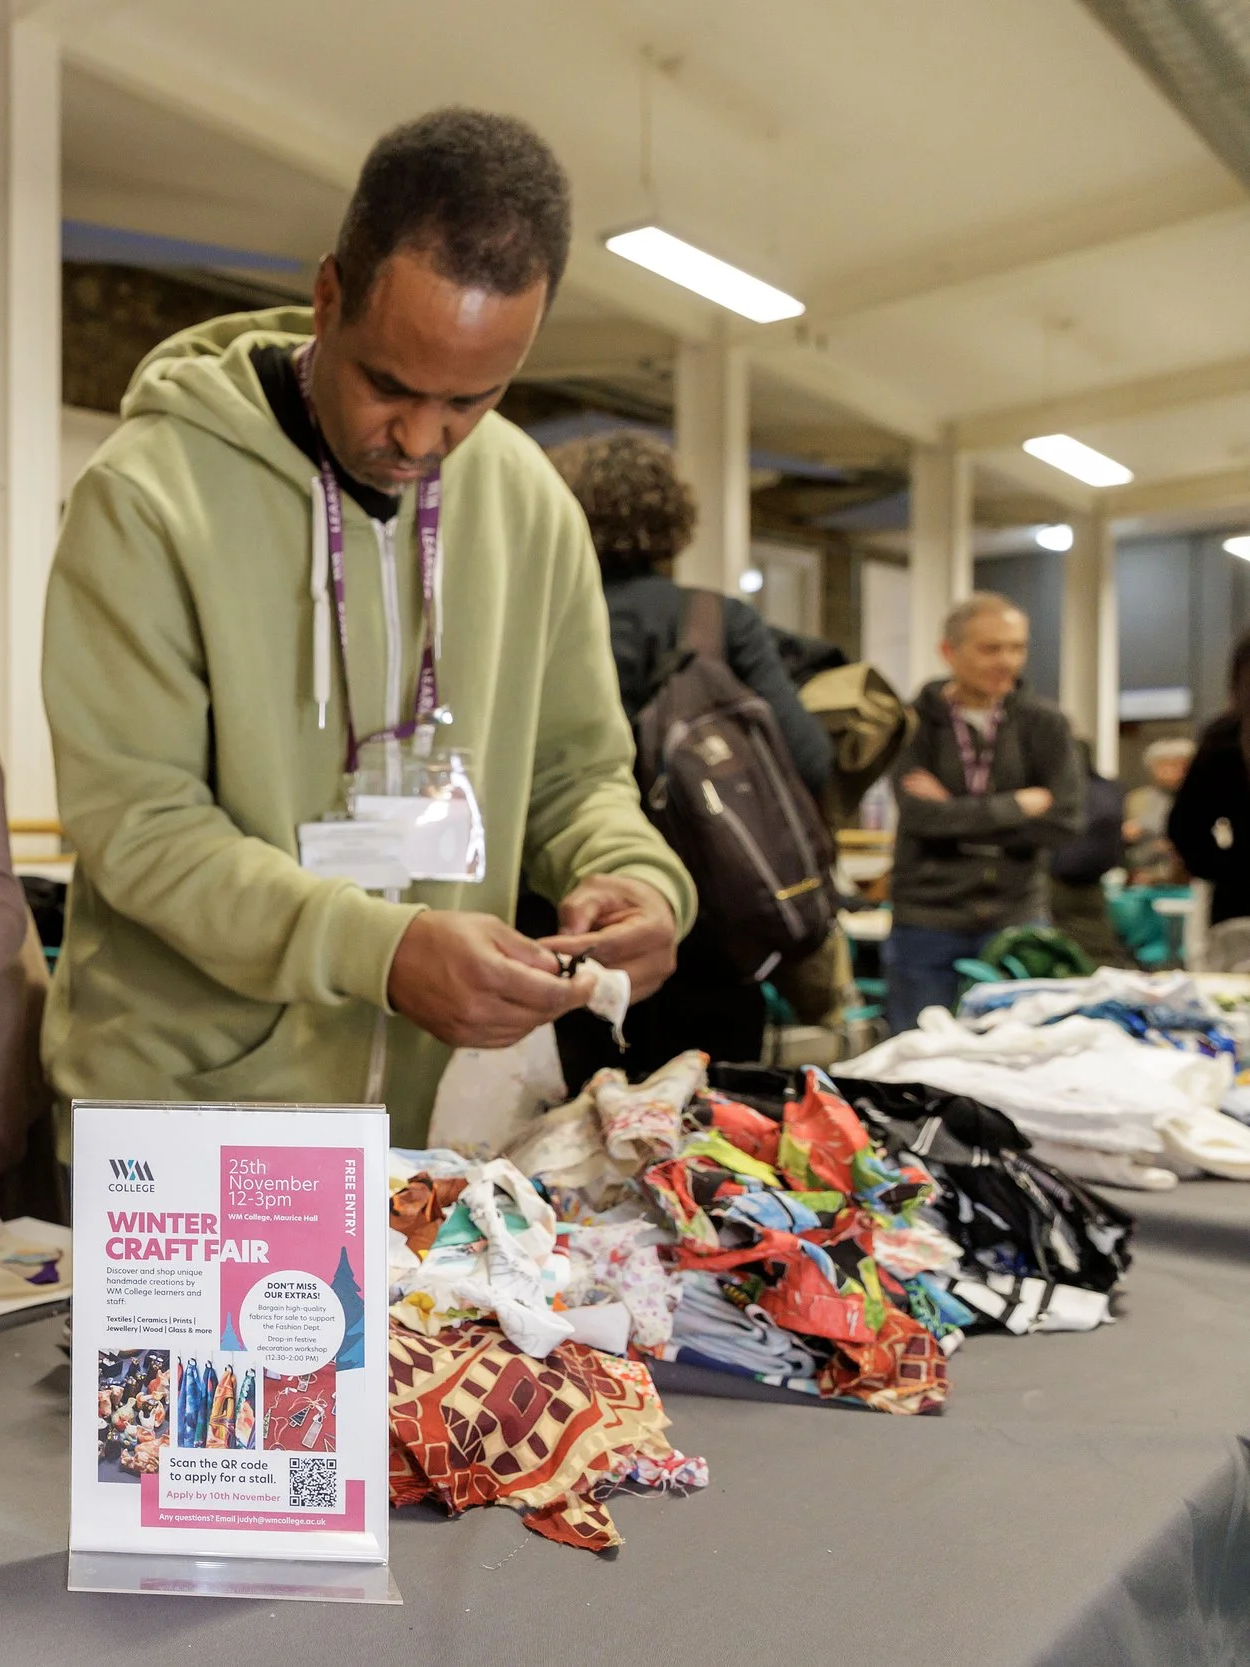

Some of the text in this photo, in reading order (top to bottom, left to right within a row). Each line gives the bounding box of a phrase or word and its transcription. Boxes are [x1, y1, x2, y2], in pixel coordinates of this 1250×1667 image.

[109, 1159, 154, 1181] WM
[229, 1159, 266, 1175] 25th
[108, 1184, 155, 1193] COLLEGE
[229, 1175, 319, 1191] November
[229, 1191, 291, 1210] 12-3pm
[344, 1160, 356, 1237] FREE ENTRY
[107, 1211, 218, 1234] WINTER
[244, 1214, 272, 1222] College,
[105, 1237, 270, 1263] CRAFT FAIR
[106, 1266, 203, 1277] Discover and shop unique
[106, 1277, 195, 1287] handmade creations by
[124, 1288, 152, 1297] College
[154, 1288, 185, 1296] learners
[186, 1289, 202, 1297] and
[264, 1291, 320, 1300] OUR EXTRAS!
[258, 1304, 326, 1313] Bargain high-quality
[106, 1325, 138, 1333] Jewellery
[267, 1335, 293, 1343] Drop-in
[170, 1458, 268, 1470] Scan the QR code
[170, 1473, 181, 1481] to
[184, 1472, 217, 1484] apply
[219, 1472, 236, 1482] for
[249, 1473, 277, 1484] stall.
[166, 1490, 281, 1502] Apply by 10th November
[159, 1513, 326, 1526] Any questions? Email judyh@wmcollege.ac.uk
